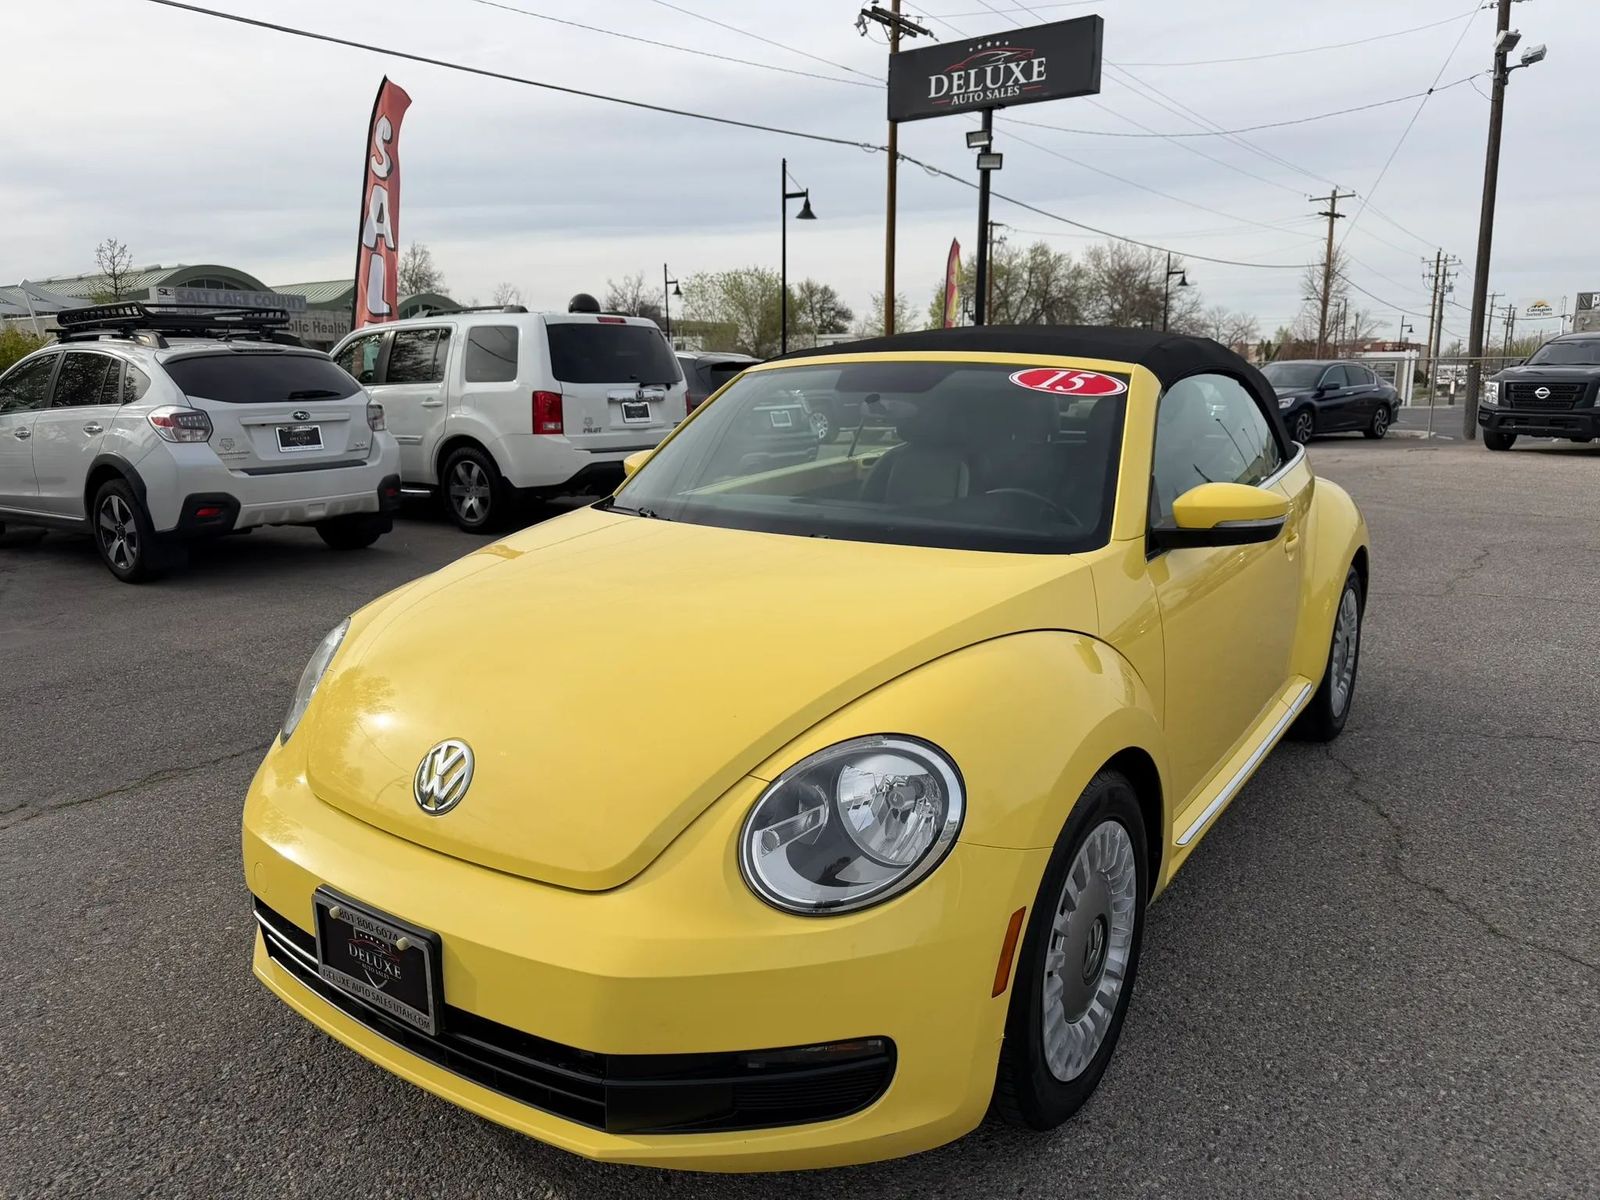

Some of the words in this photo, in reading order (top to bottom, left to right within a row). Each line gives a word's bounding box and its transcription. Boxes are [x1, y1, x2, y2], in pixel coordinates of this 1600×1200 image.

[927, 57, 1047, 98] DELUXE
[951, 92, 984, 106] AUTO
[986, 85, 1020, 100] SALES
[363, 113, 395, 326] SAL
[177, 290, 209, 304] SALT
[215, 292, 249, 306] LAKE
[254, 294, 304, 309] COUNTY
[313, 321, 347, 334] Health
[1032, 370, 1097, 392] 15
[348, 942, 401, 979] DELUXE
